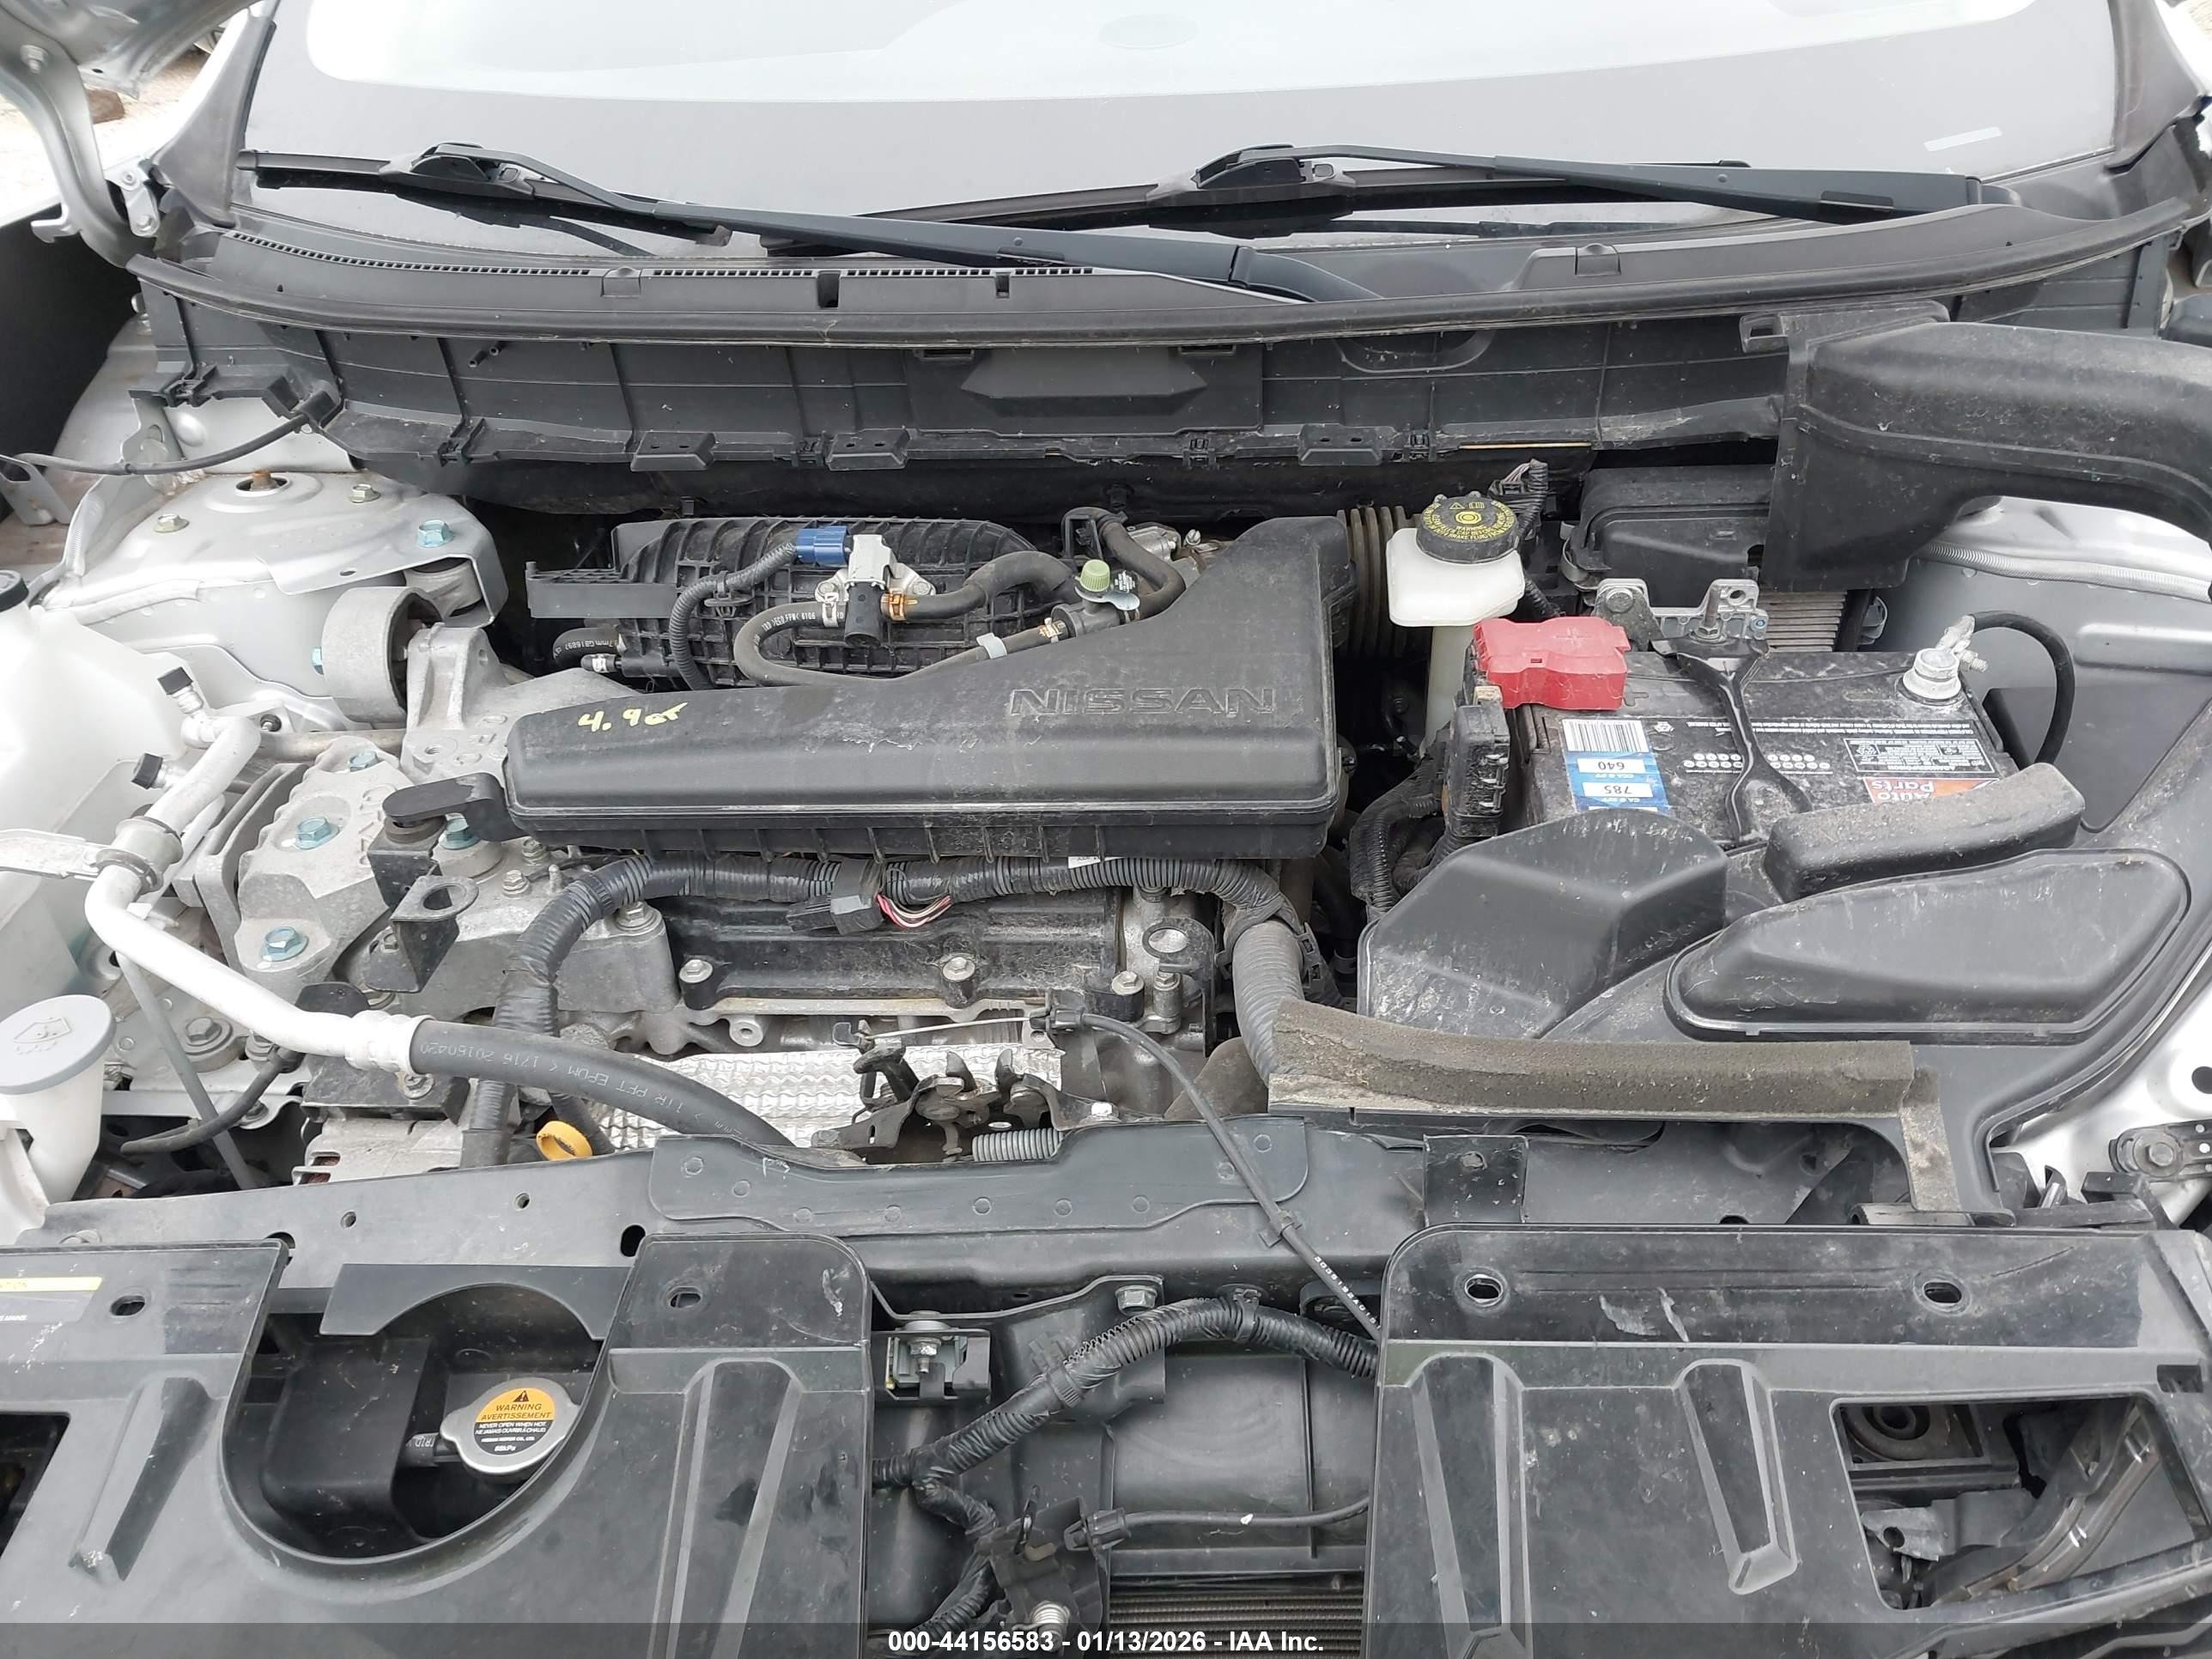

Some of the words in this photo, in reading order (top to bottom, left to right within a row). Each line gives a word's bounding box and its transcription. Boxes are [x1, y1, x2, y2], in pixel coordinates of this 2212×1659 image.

[1010, 688, 1276, 715] NISSAN
[1596, 761, 1626, 771] 640
[1603, 785, 1632, 795] 785
[1870, 780, 1936, 793] Parts
[1877, 791, 1931, 802] Auto
[495, 1403, 543, 1412] WARNING
[480, 1411, 552, 1421] AVERTISSEMENT
